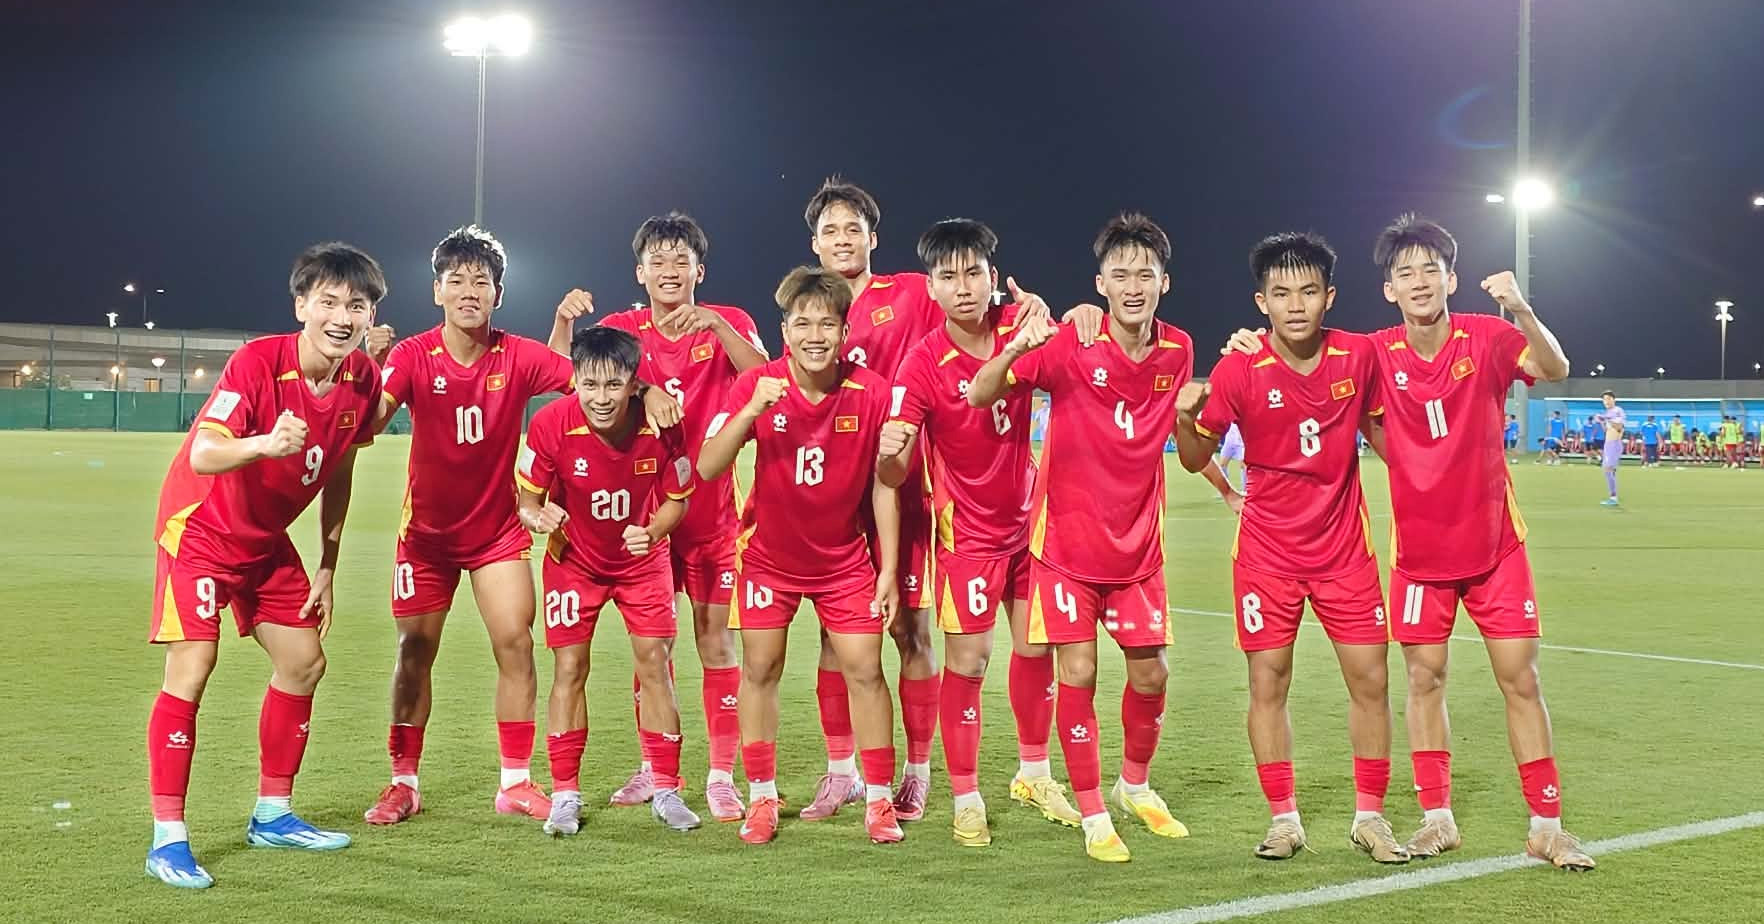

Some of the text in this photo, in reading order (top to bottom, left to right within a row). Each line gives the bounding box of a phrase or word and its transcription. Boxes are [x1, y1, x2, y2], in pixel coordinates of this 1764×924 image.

[665, 378, 684, 407] 5
[456, 406, 484, 444] 10
[992, 399, 1012, 435] 6
[1114, 401, 1134, 439] 4
[1425, 399, 1448, 440] 11
[1299, 418, 1321, 457] 8
[301, 446, 323, 486] 9
[796, 447, 825, 485] 13
[591, 489, 630, 521] 20
[197, 578, 216, 619] 9
[545, 590, 580, 627] 20
[968, 577, 988, 616] 6
[1055, 583, 1078, 623] 4
[1242, 592, 1264, 633] 8
[1403, 584, 1424, 624] 11
